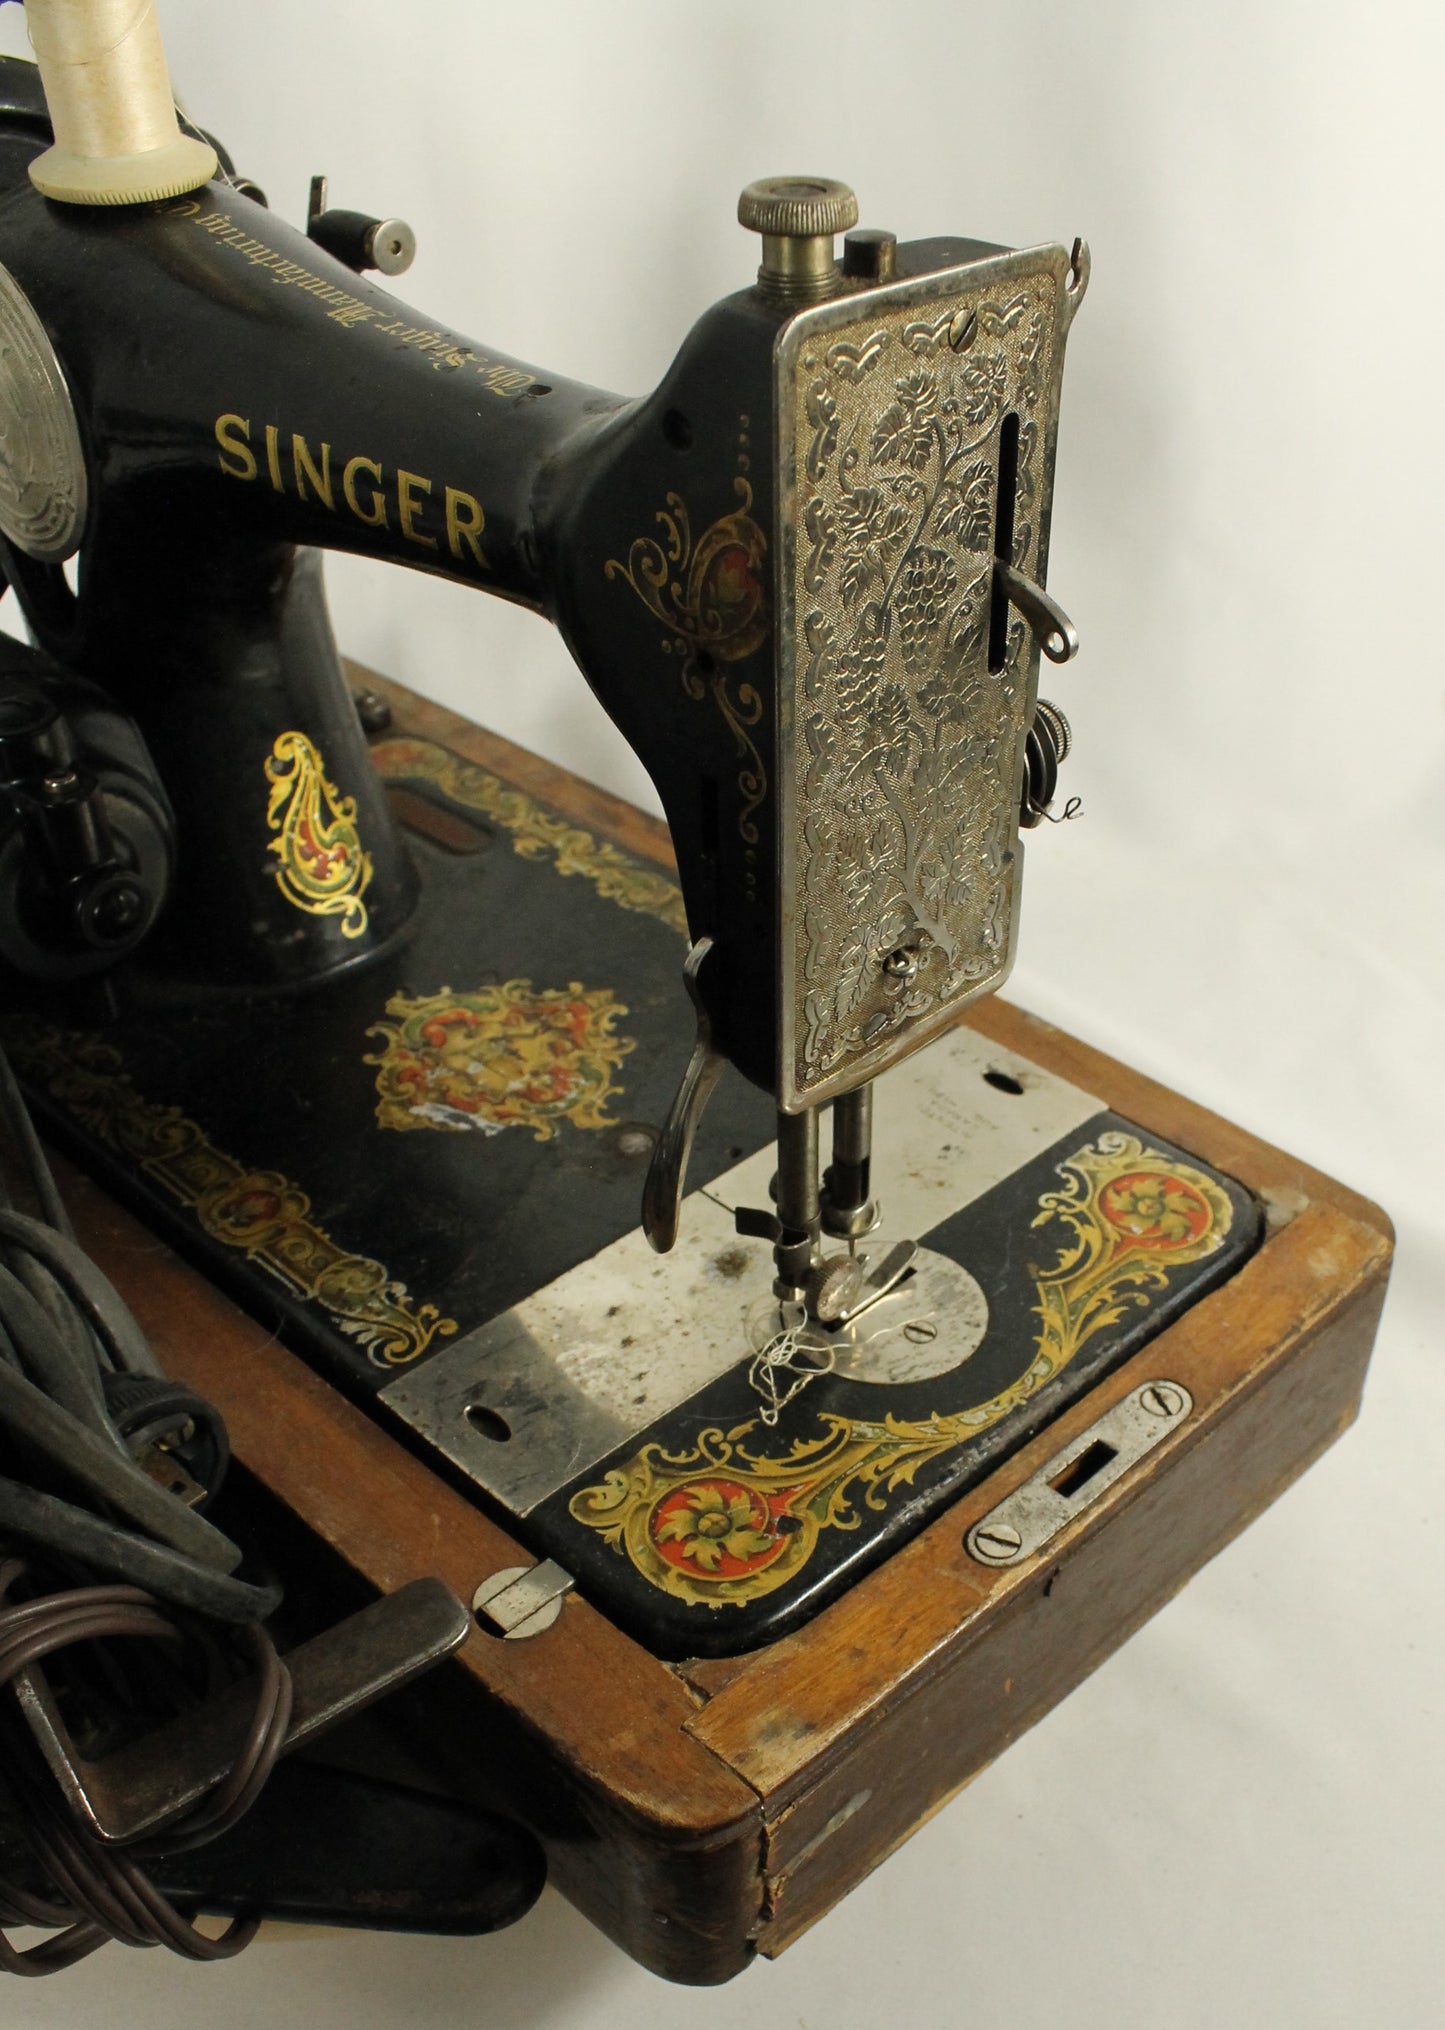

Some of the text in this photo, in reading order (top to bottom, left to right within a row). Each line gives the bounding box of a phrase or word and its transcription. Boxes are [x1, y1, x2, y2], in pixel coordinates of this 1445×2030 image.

[192, 212, 396, 328] Manufacturing
[374, 321, 488, 371] Singer
[477, 365, 536, 397] The
[214, 413, 491, 569] SINGER
